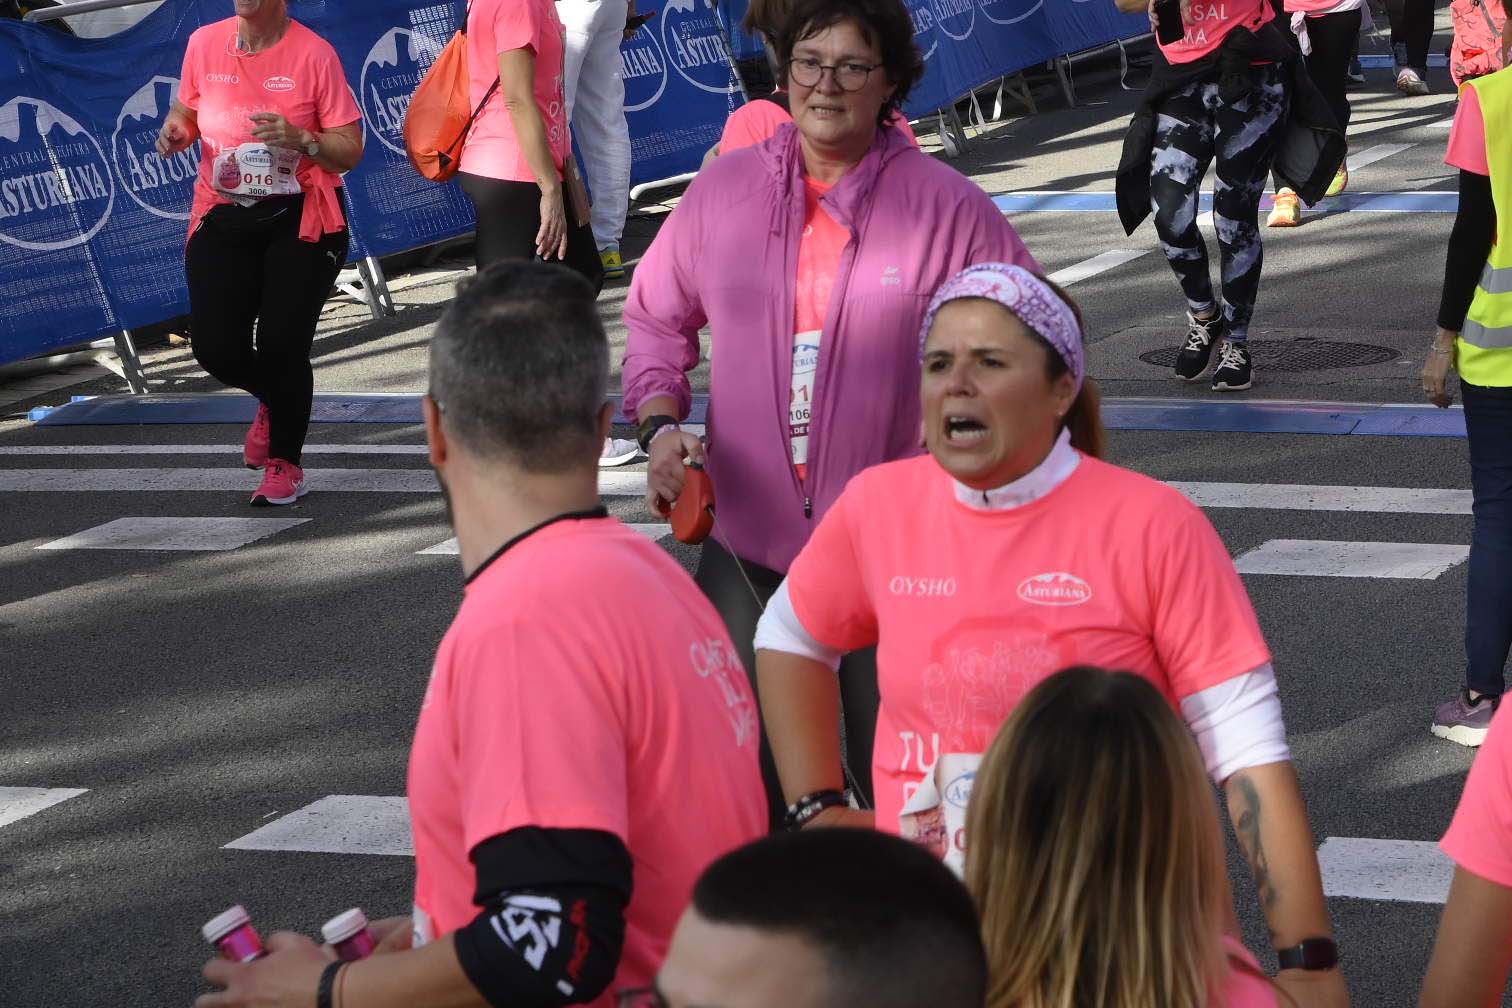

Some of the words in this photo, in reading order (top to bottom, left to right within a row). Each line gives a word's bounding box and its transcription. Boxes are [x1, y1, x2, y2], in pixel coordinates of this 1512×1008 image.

[1193, 3, 1230, 22] SAL
[671, 25, 728, 69] ASTUR
[206, 73, 239, 85] OYSHO
[243, 173, 273, 185] 016
[889, 575, 956, 597] OYSHO
[1022, 582, 1087, 601] ASTURIANA
[899, 731, 939, 773] TU
